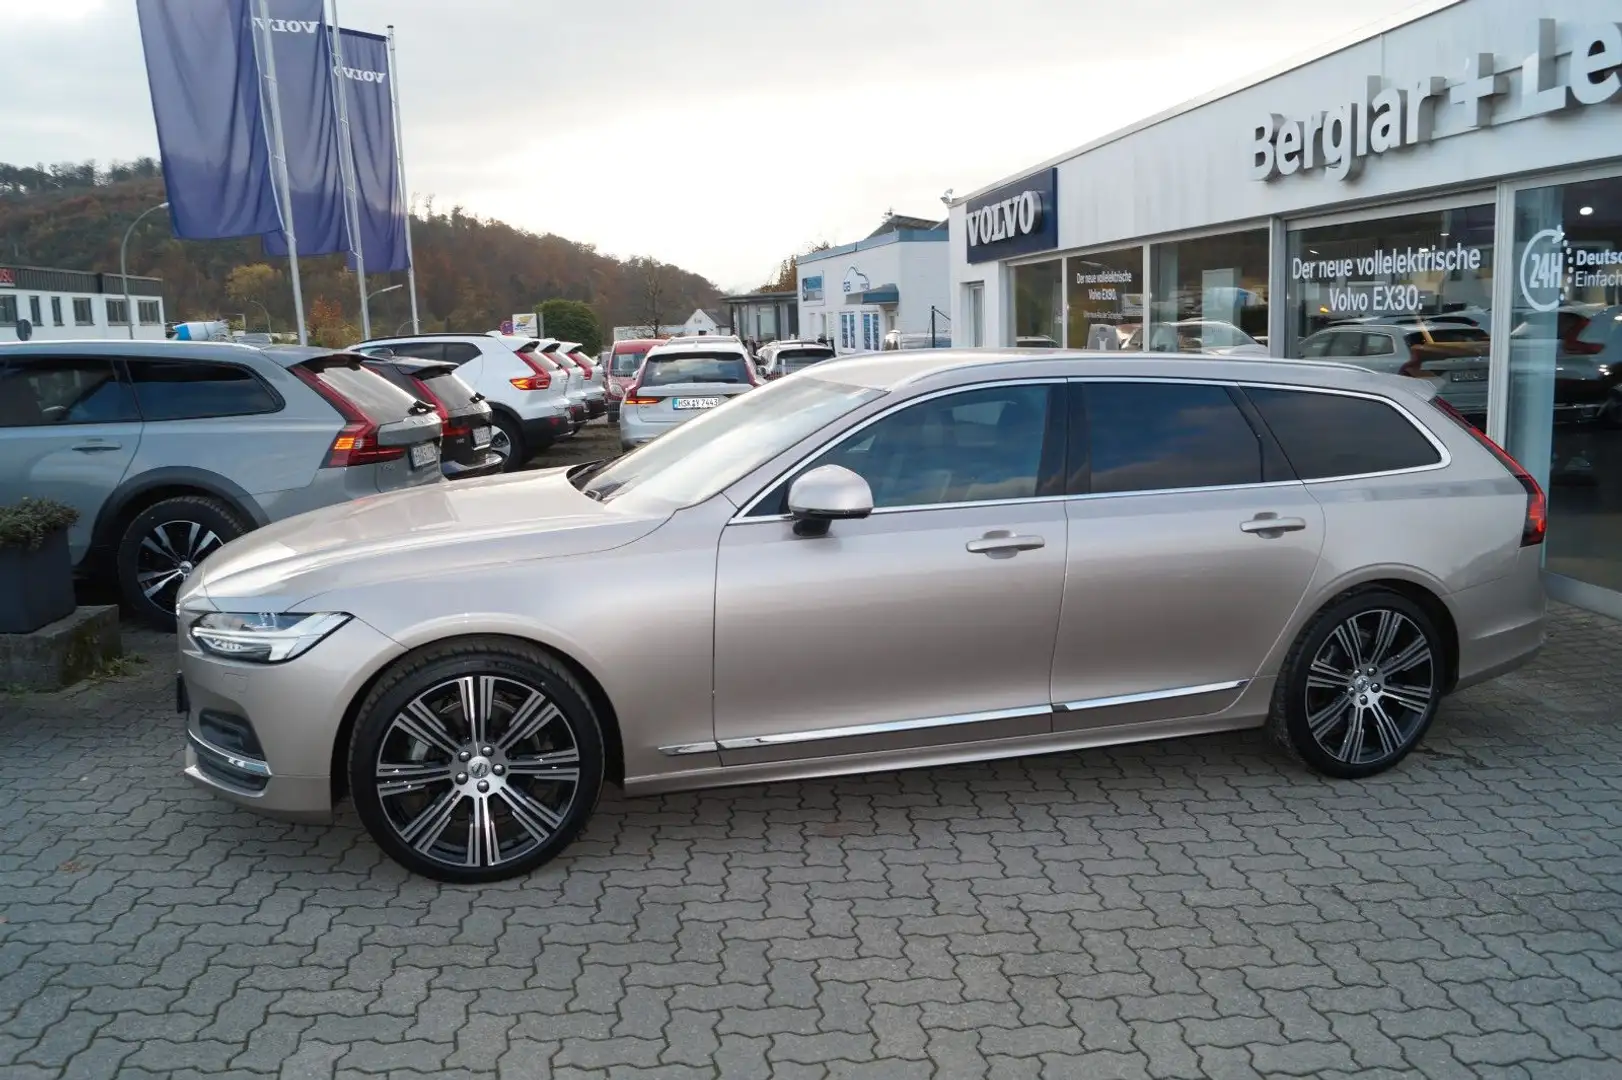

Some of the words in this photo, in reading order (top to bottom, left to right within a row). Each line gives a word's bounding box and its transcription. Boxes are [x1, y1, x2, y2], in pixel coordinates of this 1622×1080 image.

[1250, 75, 1433, 182] Berglar
[966, 190, 1036, 247] VOLVO
[1292, 257, 1317, 280] Der
[1319, 258, 1352, 279] neue
[1356, 242, 1481, 276] vollelektrische
[1529, 252, 1563, 289] 24H
[1329, 287, 1368, 312] Volvo
